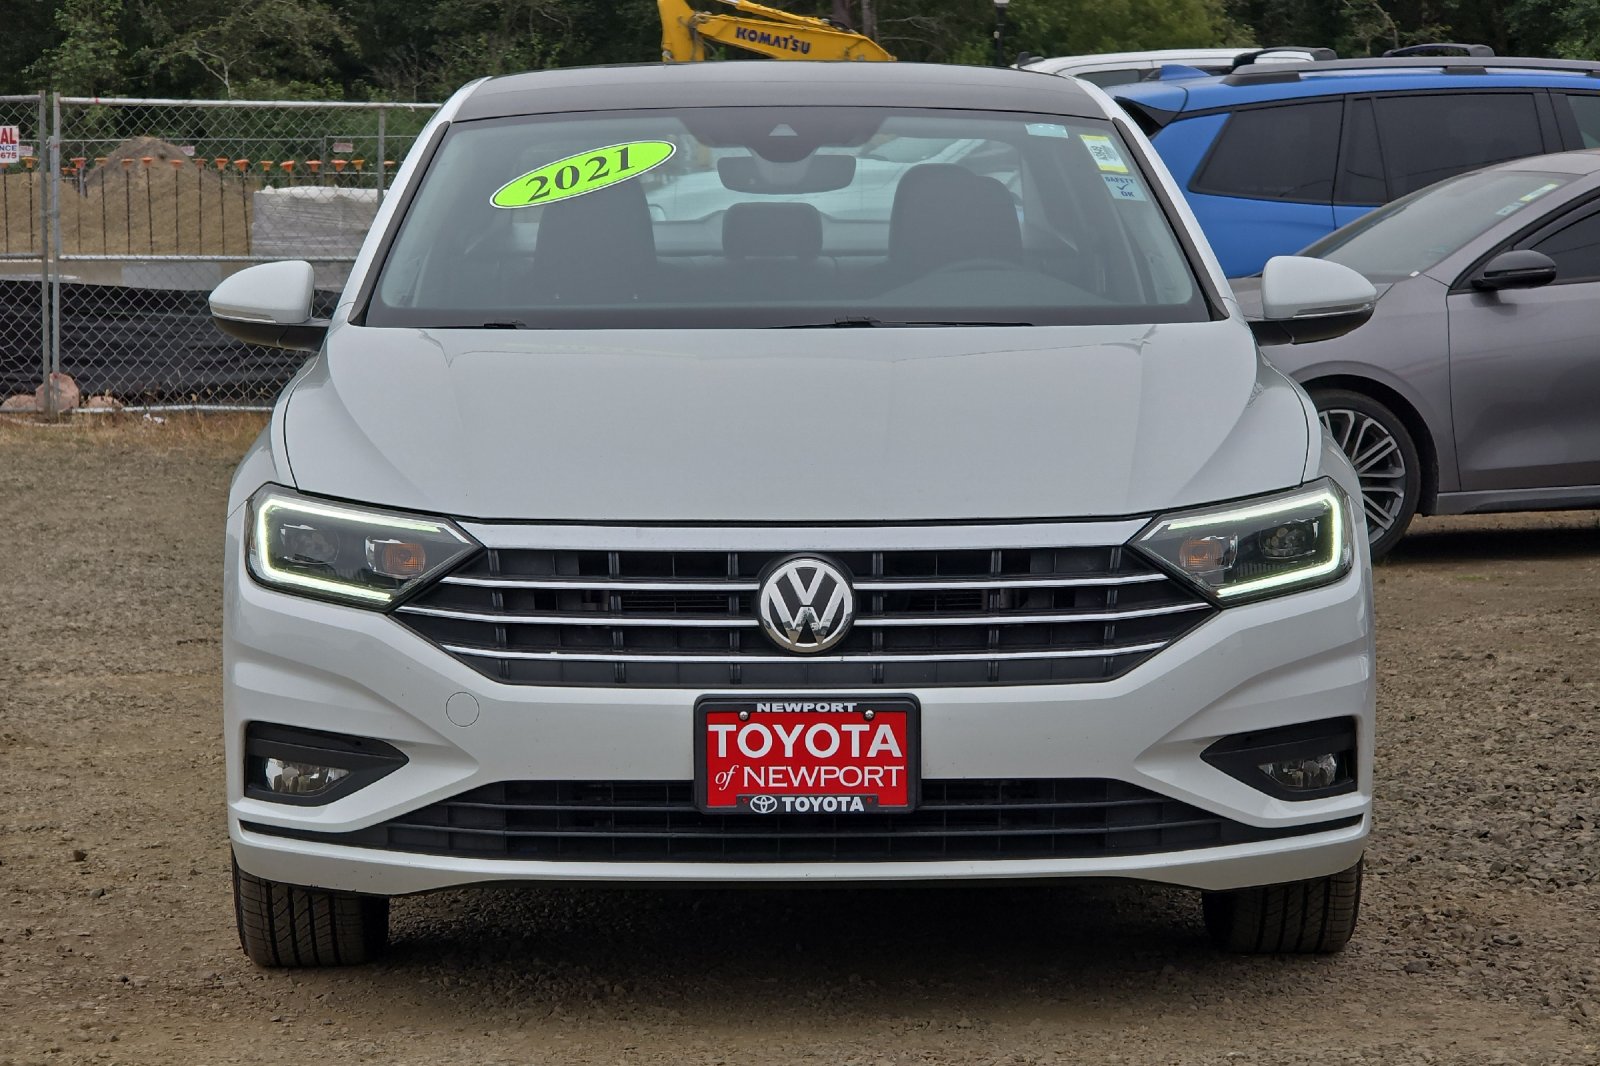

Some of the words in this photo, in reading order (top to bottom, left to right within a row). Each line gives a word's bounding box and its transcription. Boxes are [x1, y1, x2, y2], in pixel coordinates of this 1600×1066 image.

[735, 26, 811, 54] KOMATSU
[525, 146, 635, 202] 2021
[1104, 176, 1135, 184] SAFETY
[756, 702, 857, 712] NEWPORT
[707, 722, 903, 759] TOYOTA
[714, 764, 740, 791] of
[743, 765, 905, 787] NEWPORT
[781, 796, 865, 813] TOYOTA
